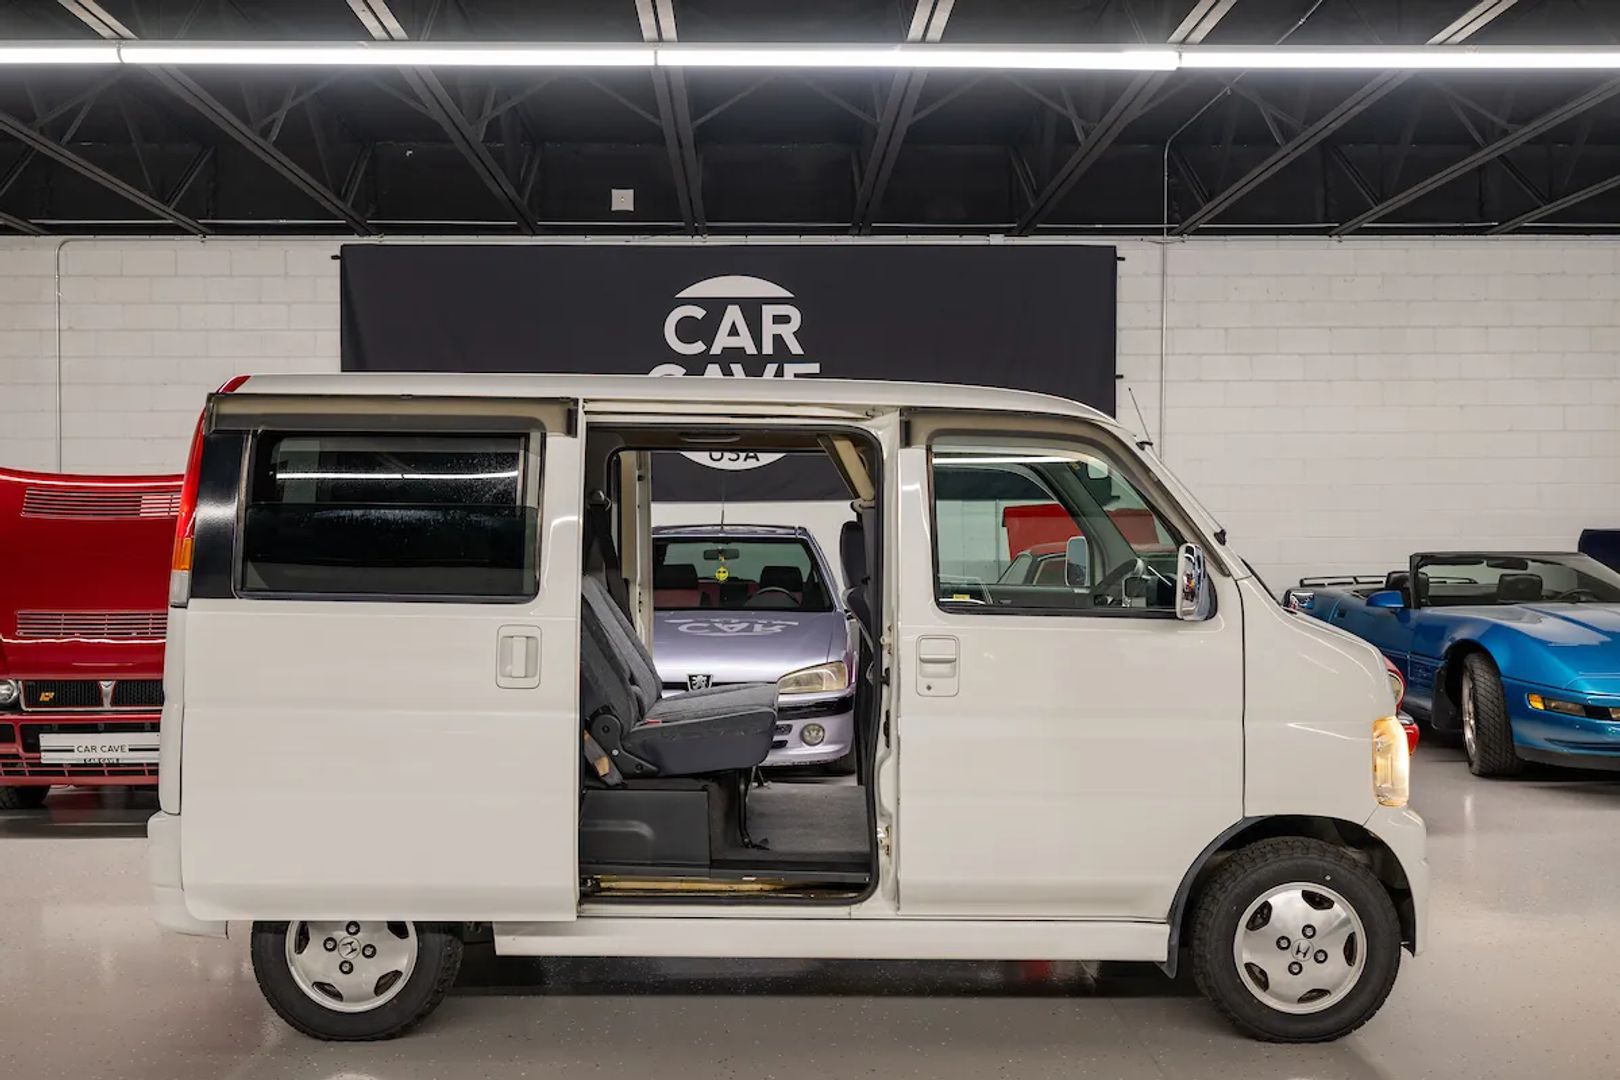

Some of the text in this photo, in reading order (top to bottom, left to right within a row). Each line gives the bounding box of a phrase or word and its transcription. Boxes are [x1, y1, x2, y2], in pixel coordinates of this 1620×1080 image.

[664, 304, 804, 355] CAR
[76, 745, 127, 753] CAR CAVE
